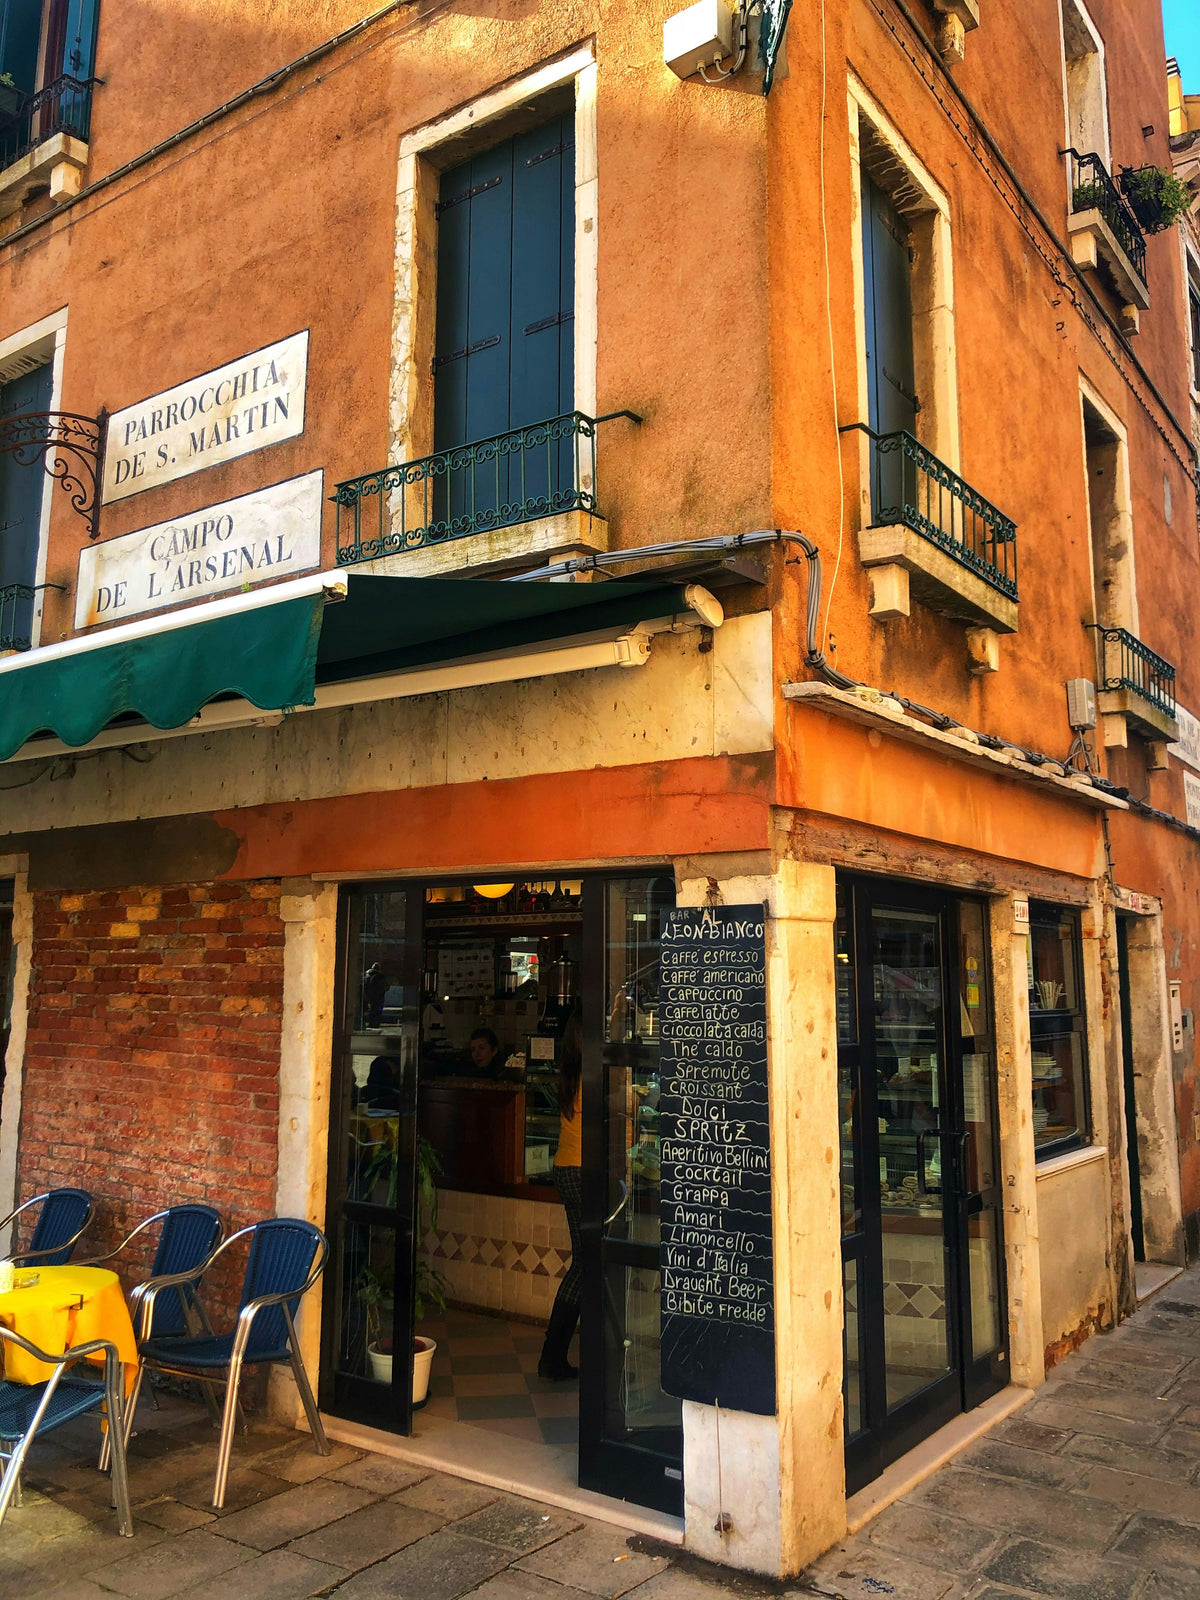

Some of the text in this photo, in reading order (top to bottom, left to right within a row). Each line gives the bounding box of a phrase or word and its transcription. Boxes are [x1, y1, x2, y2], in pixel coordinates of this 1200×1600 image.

[123, 360, 280, 446] PARROCCHIA
[114, 392, 291, 486] DE S. MARTIN
[150, 514, 234, 562] CAMPO
[96, 581, 128, 614] DE
[670, 910, 690, 921] BAR
[703, 970, 765, 984] americano
[668, 988, 743, 1001] Cappuccino
[734, 1022, 764, 1038] calda
[705, 1040, 743, 1057] caldo
[676, 1062, 750, 1080] Spremute
[682, 1097, 726, 1121] Dolci
[662, 1141, 768, 1168] Aperitivo Bellini
[673, 1185, 729, 1206] Grappa
[674, 1205, 723, 1228] Amari
[670, 1225, 754, 1253] Limoncello
[667, 1247, 691, 1267] Vini
[728, 1276, 766, 1300] Beer
[666, 1292, 714, 1315] Bibite
